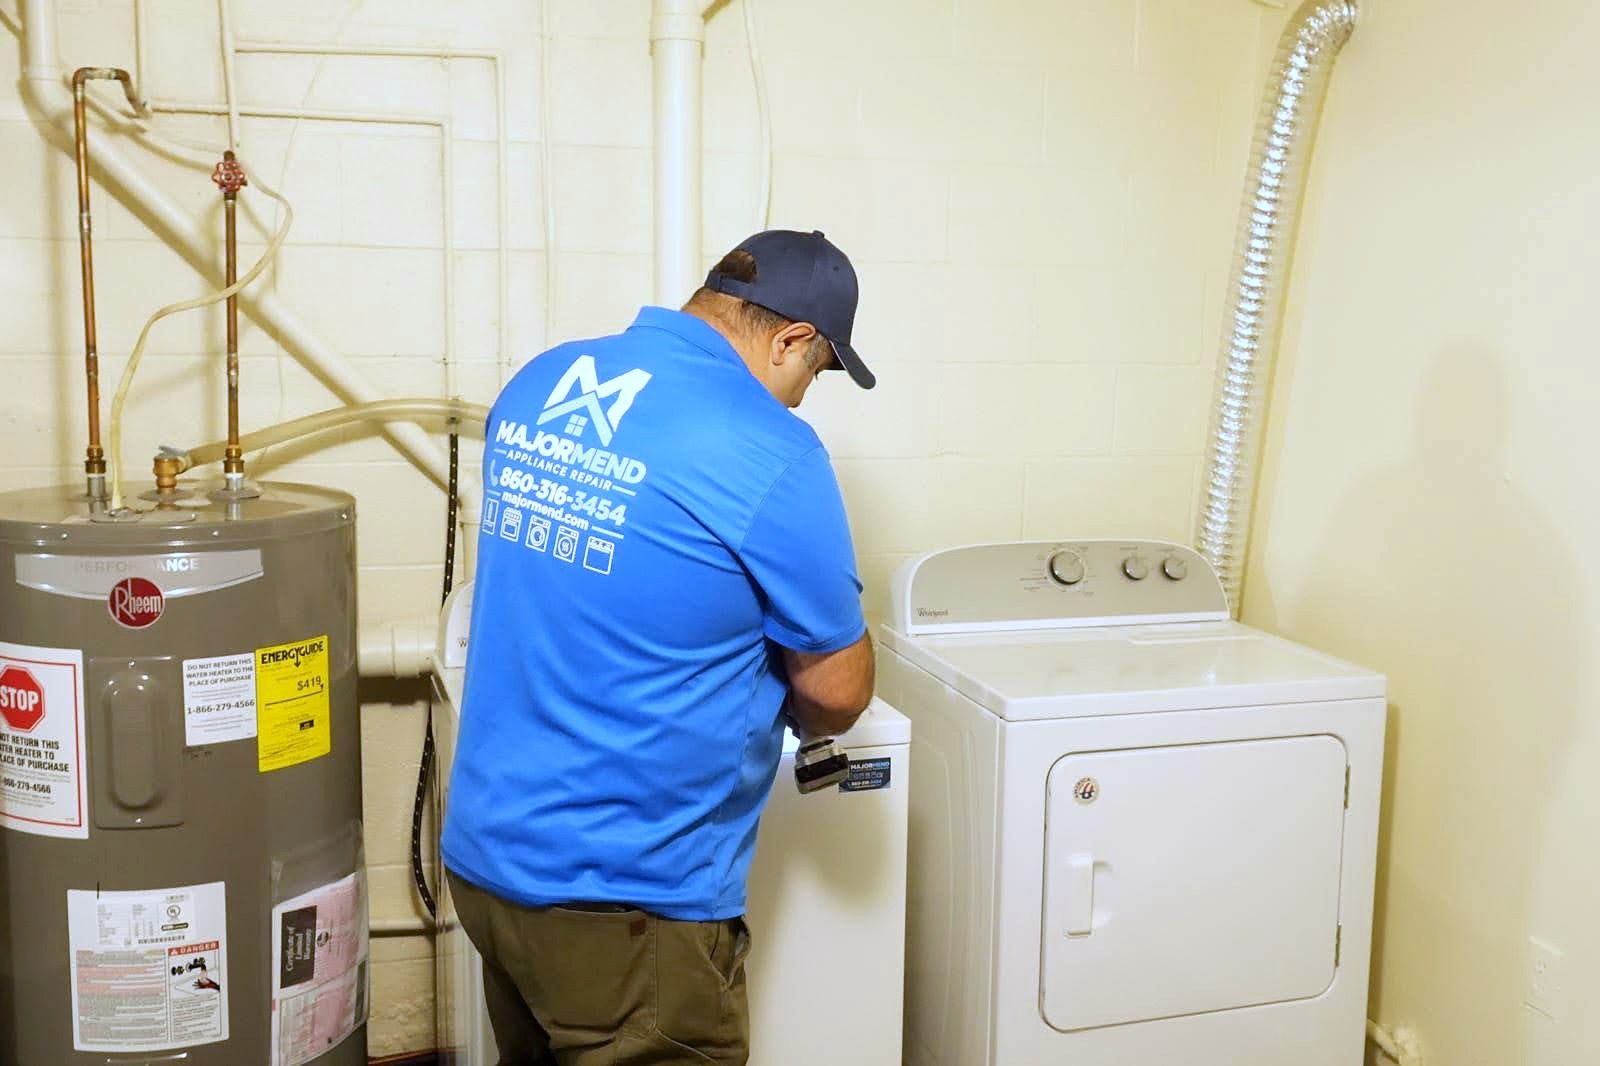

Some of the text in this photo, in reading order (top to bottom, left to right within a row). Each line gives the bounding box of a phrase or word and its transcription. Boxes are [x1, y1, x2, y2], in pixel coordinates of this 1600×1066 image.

[495, 420, 647, 484] MAJORMEND
[506, 449, 613, 491] APPLIANCE REPAIR
[499, 466, 628, 526] 860-316-3454
[501, 491, 590, 531] majormend.com
[77, 557, 200, 573] PERFOANCE
[114, 577, 162, 621] Rheem
[199, 662, 212, 670] NOT
[213, 659, 238, 668] RETURN
[239, 658, 252, 666] THIS
[186, 671, 208, 679] WATER
[208, 668, 232, 677] HEATER
[188, 679, 209, 687] PLACE
[219, 674, 252, 684] PURCHASE
[297, 676, 322, 691] $419
[0, 685, 39, 712] STOP
[188, 699, 255, 714] 1-866-279-4566
[11, 735, 39, 747] RETURN
[42, 739, 60, 750] THIS
[15, 745, 42, 759] HEATER
[45, 751, 55, 761] TO
[16, 757, 25, 767] OF
[28, 760, 69, 772] PURCHASE
[179, 942, 218, 955] DANGER
